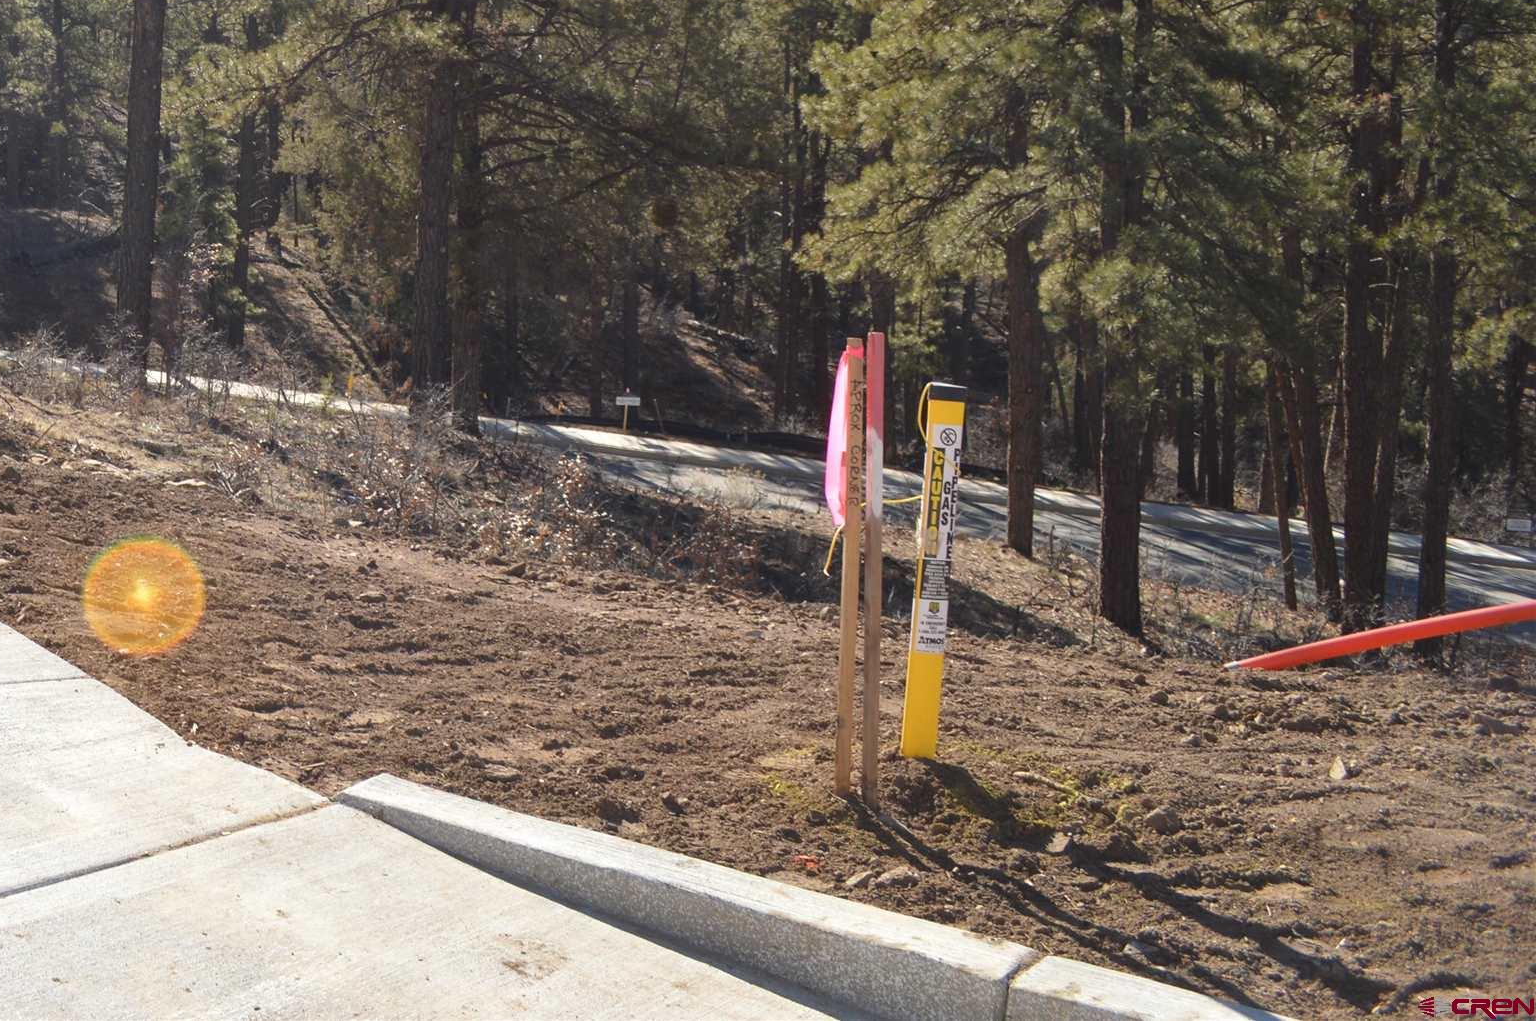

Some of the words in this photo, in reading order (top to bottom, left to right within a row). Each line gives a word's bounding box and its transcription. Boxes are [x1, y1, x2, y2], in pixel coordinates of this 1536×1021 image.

[850, 379, 863, 431] APROX
[848, 445, 861, 507] CORNER
[941, 482, 952, 526] GAS
[946, 448, 961, 559] PIPELINE
